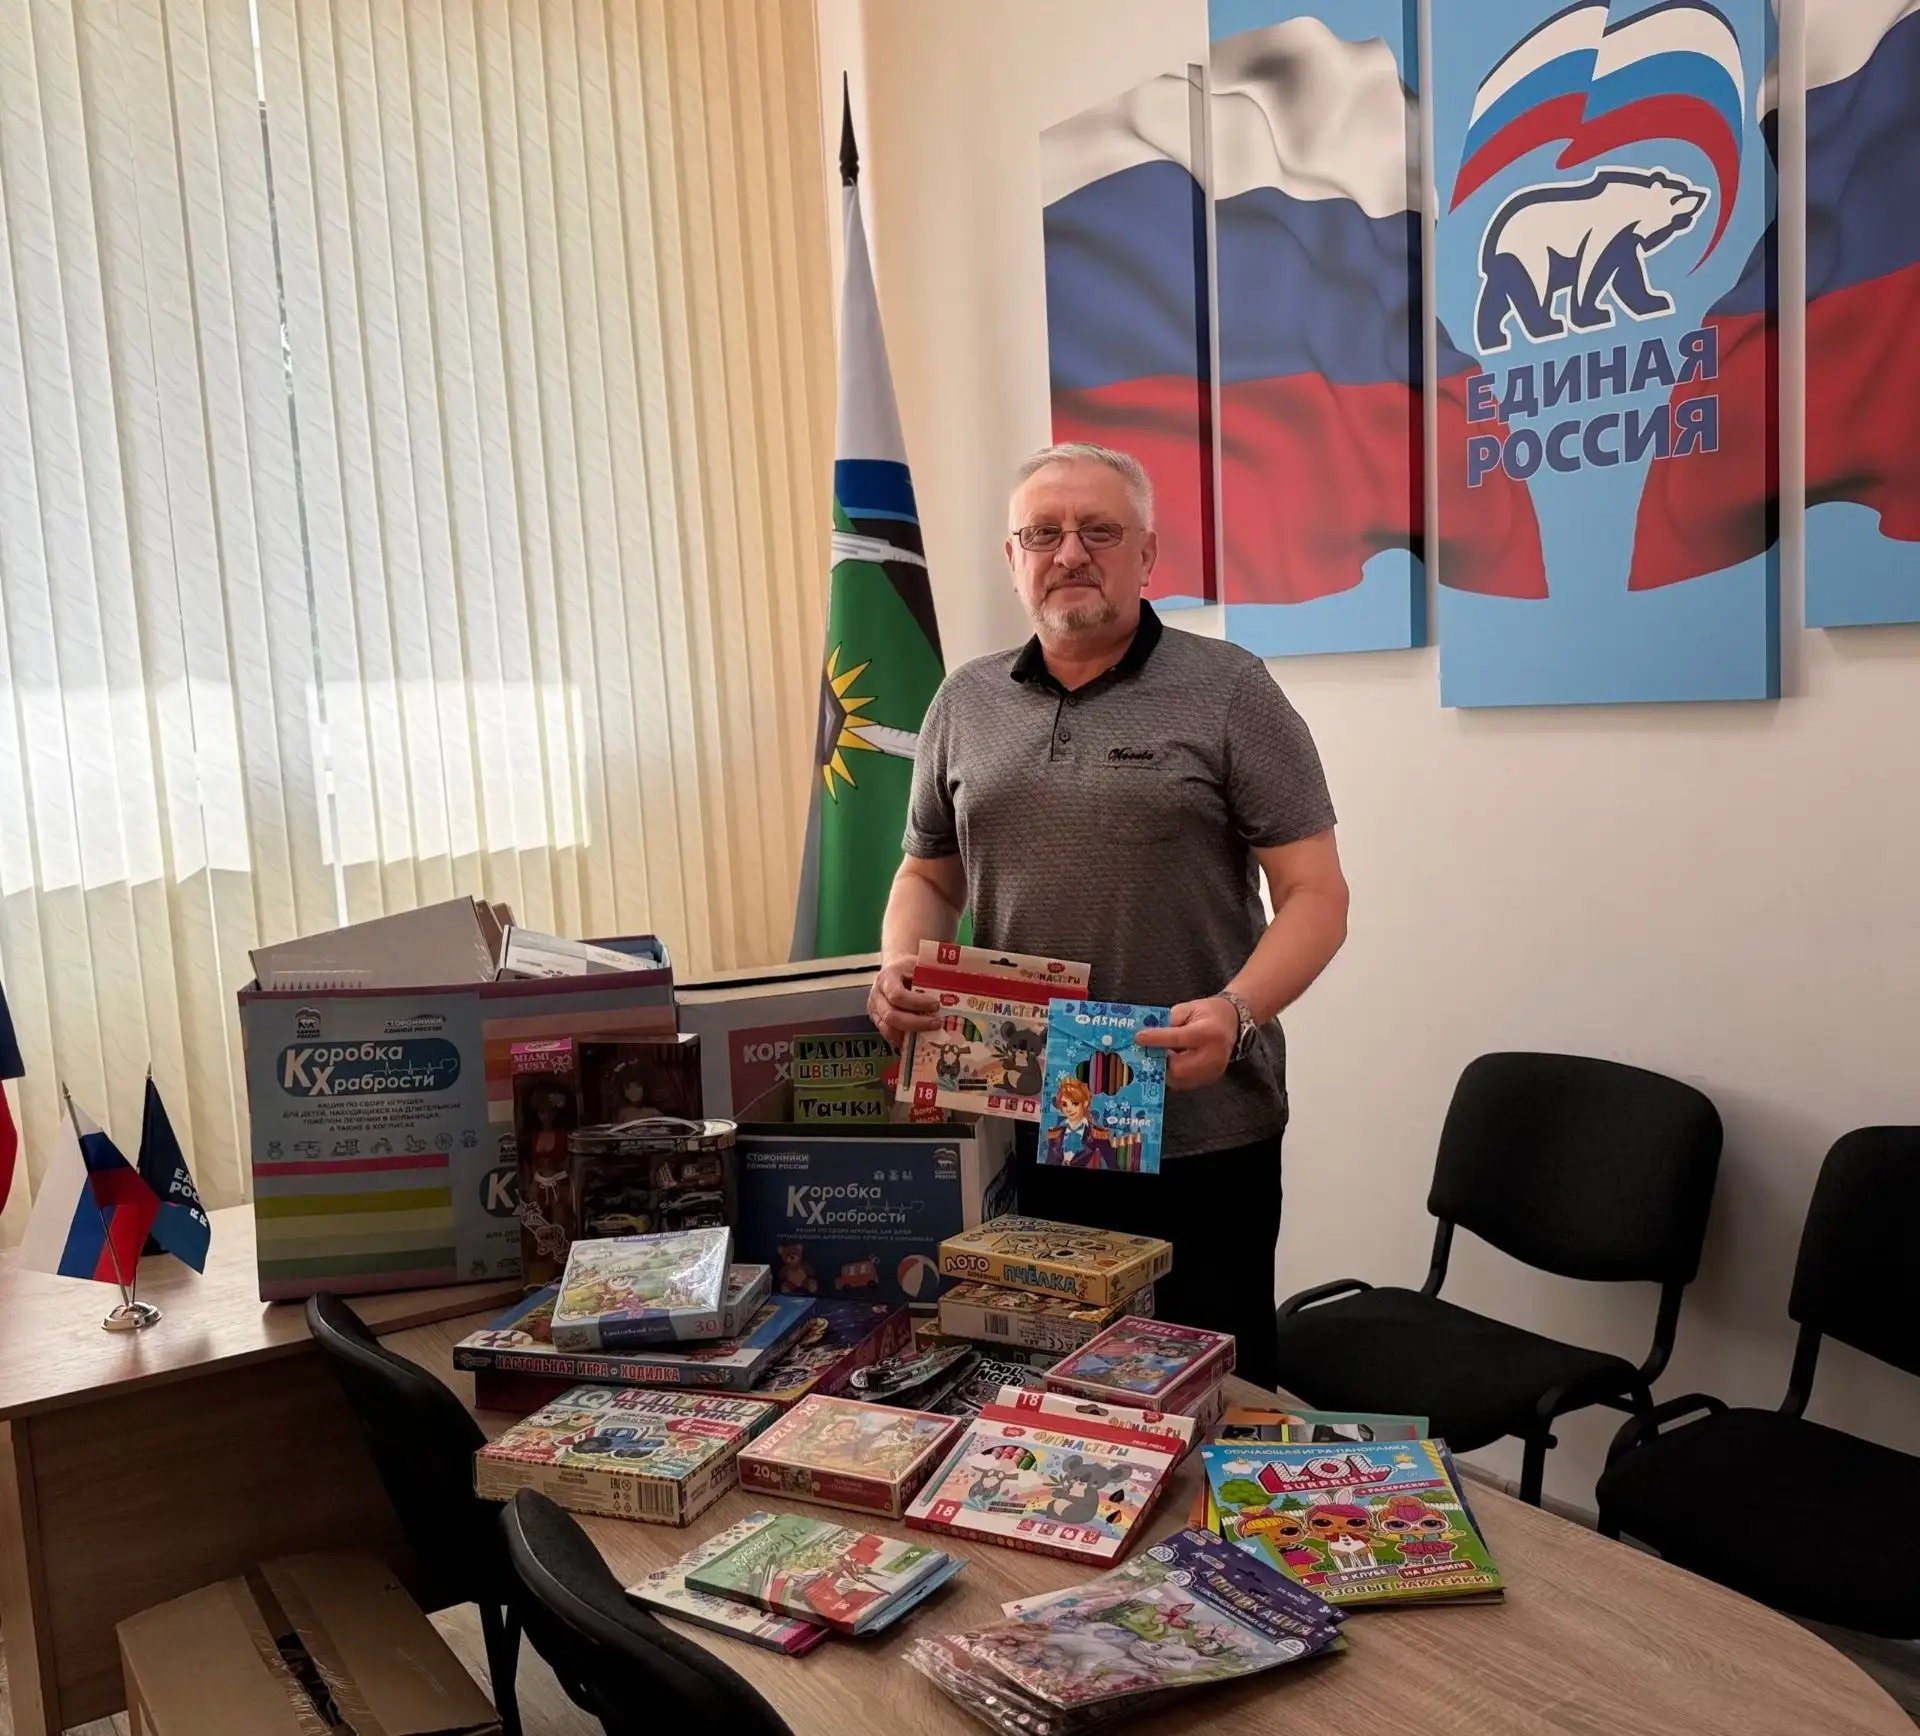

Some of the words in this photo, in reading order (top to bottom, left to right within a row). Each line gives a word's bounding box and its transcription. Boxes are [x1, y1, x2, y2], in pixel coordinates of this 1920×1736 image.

[1467, 325, 1718, 424] ЕДИНАЯ
[1467, 394, 1718, 488] РОССИЯ
[941, 948, 956, 960] 18
[1019, 969, 1081, 984] ФЛОМАСТЕРЫ
[1091, 1016, 1136, 1028] ASMAR
[283, 1042, 403, 1088] Коробка
[513, 1052, 550, 1062] MIAMI
[517, 1061, 547, 1071] SUSY
[800, 1062, 875, 1079] ЦВЕТНАЯ
[308, 1066, 435, 1096] Храбрости
[918, 1087, 932, 1099] 18
[799, 1098, 882, 1117] Тачки
[787, 1183, 882, 1217] Коробка
[806, 1200, 906, 1225] Храбрости
[945, 1254, 989, 1272] ЛОТО
[1003, 1264, 1077, 1295] ПЧЁЛКА
[693, 1319, 717, 1333] 30
[1126, 1320, 1183, 1337] PUZZLE
[495, 1355, 574, 1374] НАСТОЛЬНАЯ
[577, 1360, 608, 1377] ИГРА
[620, 1364, 680, 1382] ХОДИЛКА
[977, 1358, 1024, 1377] COOL
[560, 1389, 613, 1408] IQ
[613, 1389, 766, 1417] ЛИПУЧКИ
[1022, 1393, 1038, 1406] 18
[611, 1401, 631, 1411] ИЗ
[628, 1402, 743, 1423] ПЛАСТИКА
[804, 1403, 820, 1417] 20
[1108, 1416, 1181, 1439] ФЛОМАСТЕРЫ
[1033, 1431, 1129, 1456] ФЛОМАСТЕРЫ
[1224, 1448, 1300, 1456] ОБУЧАЮЩАЯ
[752, 1464, 770, 1479] 20
[1283, 1474, 1376, 1491] SURPRISE!
[1367, 1481, 1430, 1494] РАСКРАСКИ!
[936, 1503, 952, 1517] 18
[1341, 1573, 1348, 1581] В
[1352, 1568, 1387, 1580] КЛУБЕ
[1404, 1567, 1421, 1577] НА
[1422, 1561, 1469, 1575] ДЕФИЛЕ
[1314, 1581, 1392, 1598] РАЗОВЫЕ
[1394, 1575, 1493, 1589] НАКЛЕЙКИ!
[1200, 1568, 1316, 1636] АППЛИКАЦИЯ
